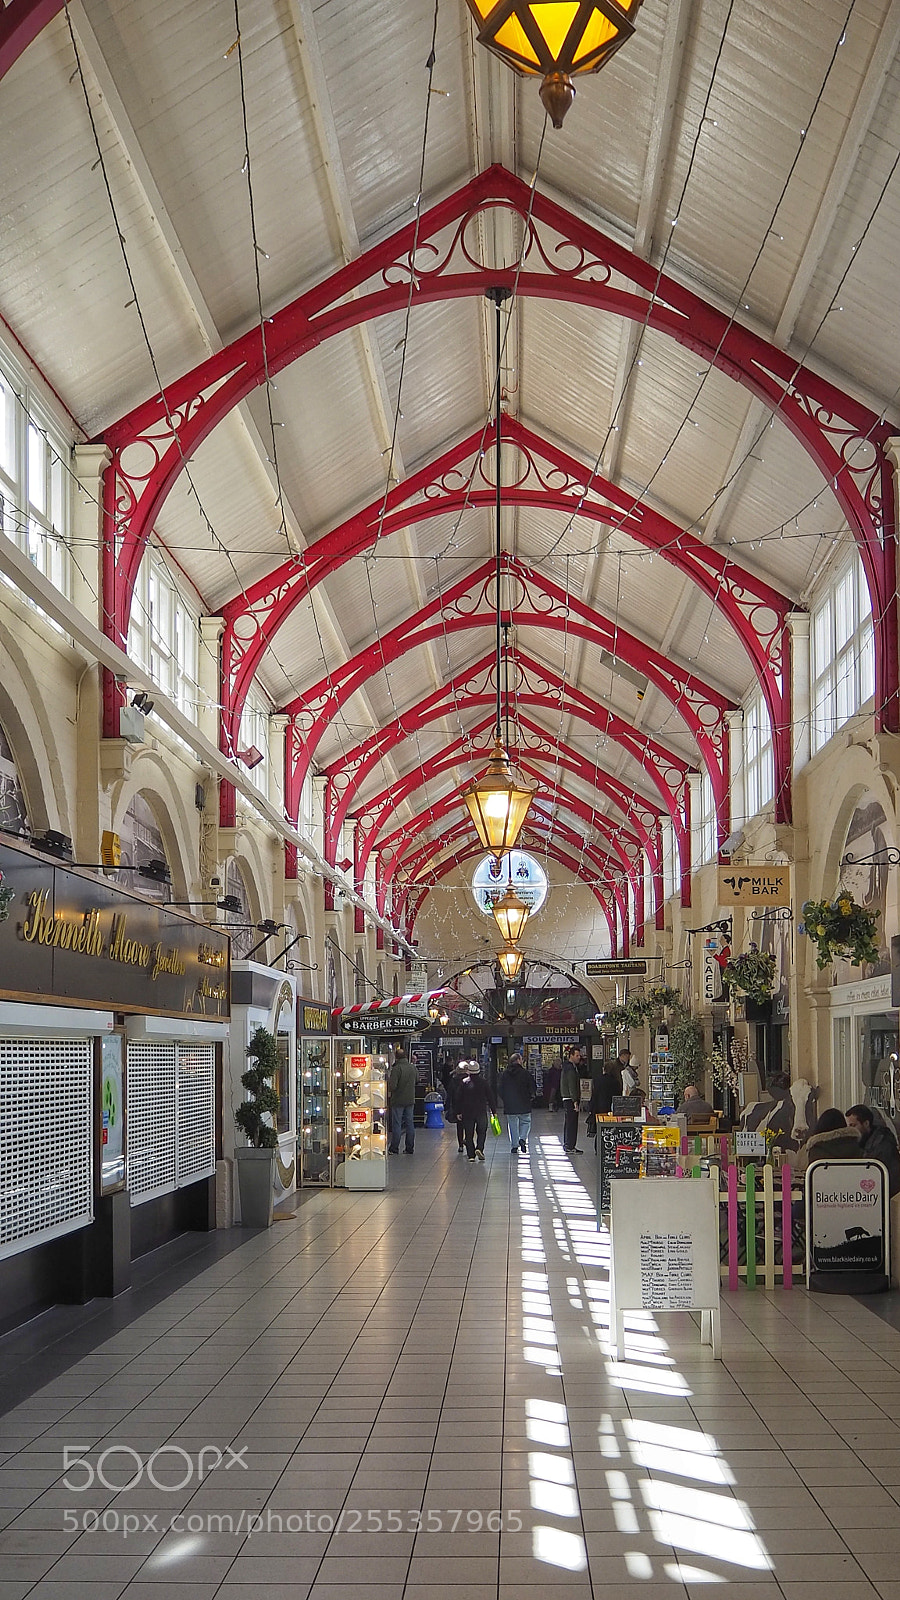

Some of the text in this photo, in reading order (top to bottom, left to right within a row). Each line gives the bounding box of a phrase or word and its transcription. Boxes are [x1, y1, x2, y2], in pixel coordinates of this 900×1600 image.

[752, 878, 784, 886] MILK
[752, 886, 779, 895] BAR
[23, 887, 105, 957] Kenneth
[109, 913, 150, 968] Moore
[705, 956, 713, 992] CAFE
[352, 1018, 418, 1030] BARBER SHOP
[545, 1026, 578, 1034] Market
[816, 1192, 878, 1206] Black Isle Dairy
